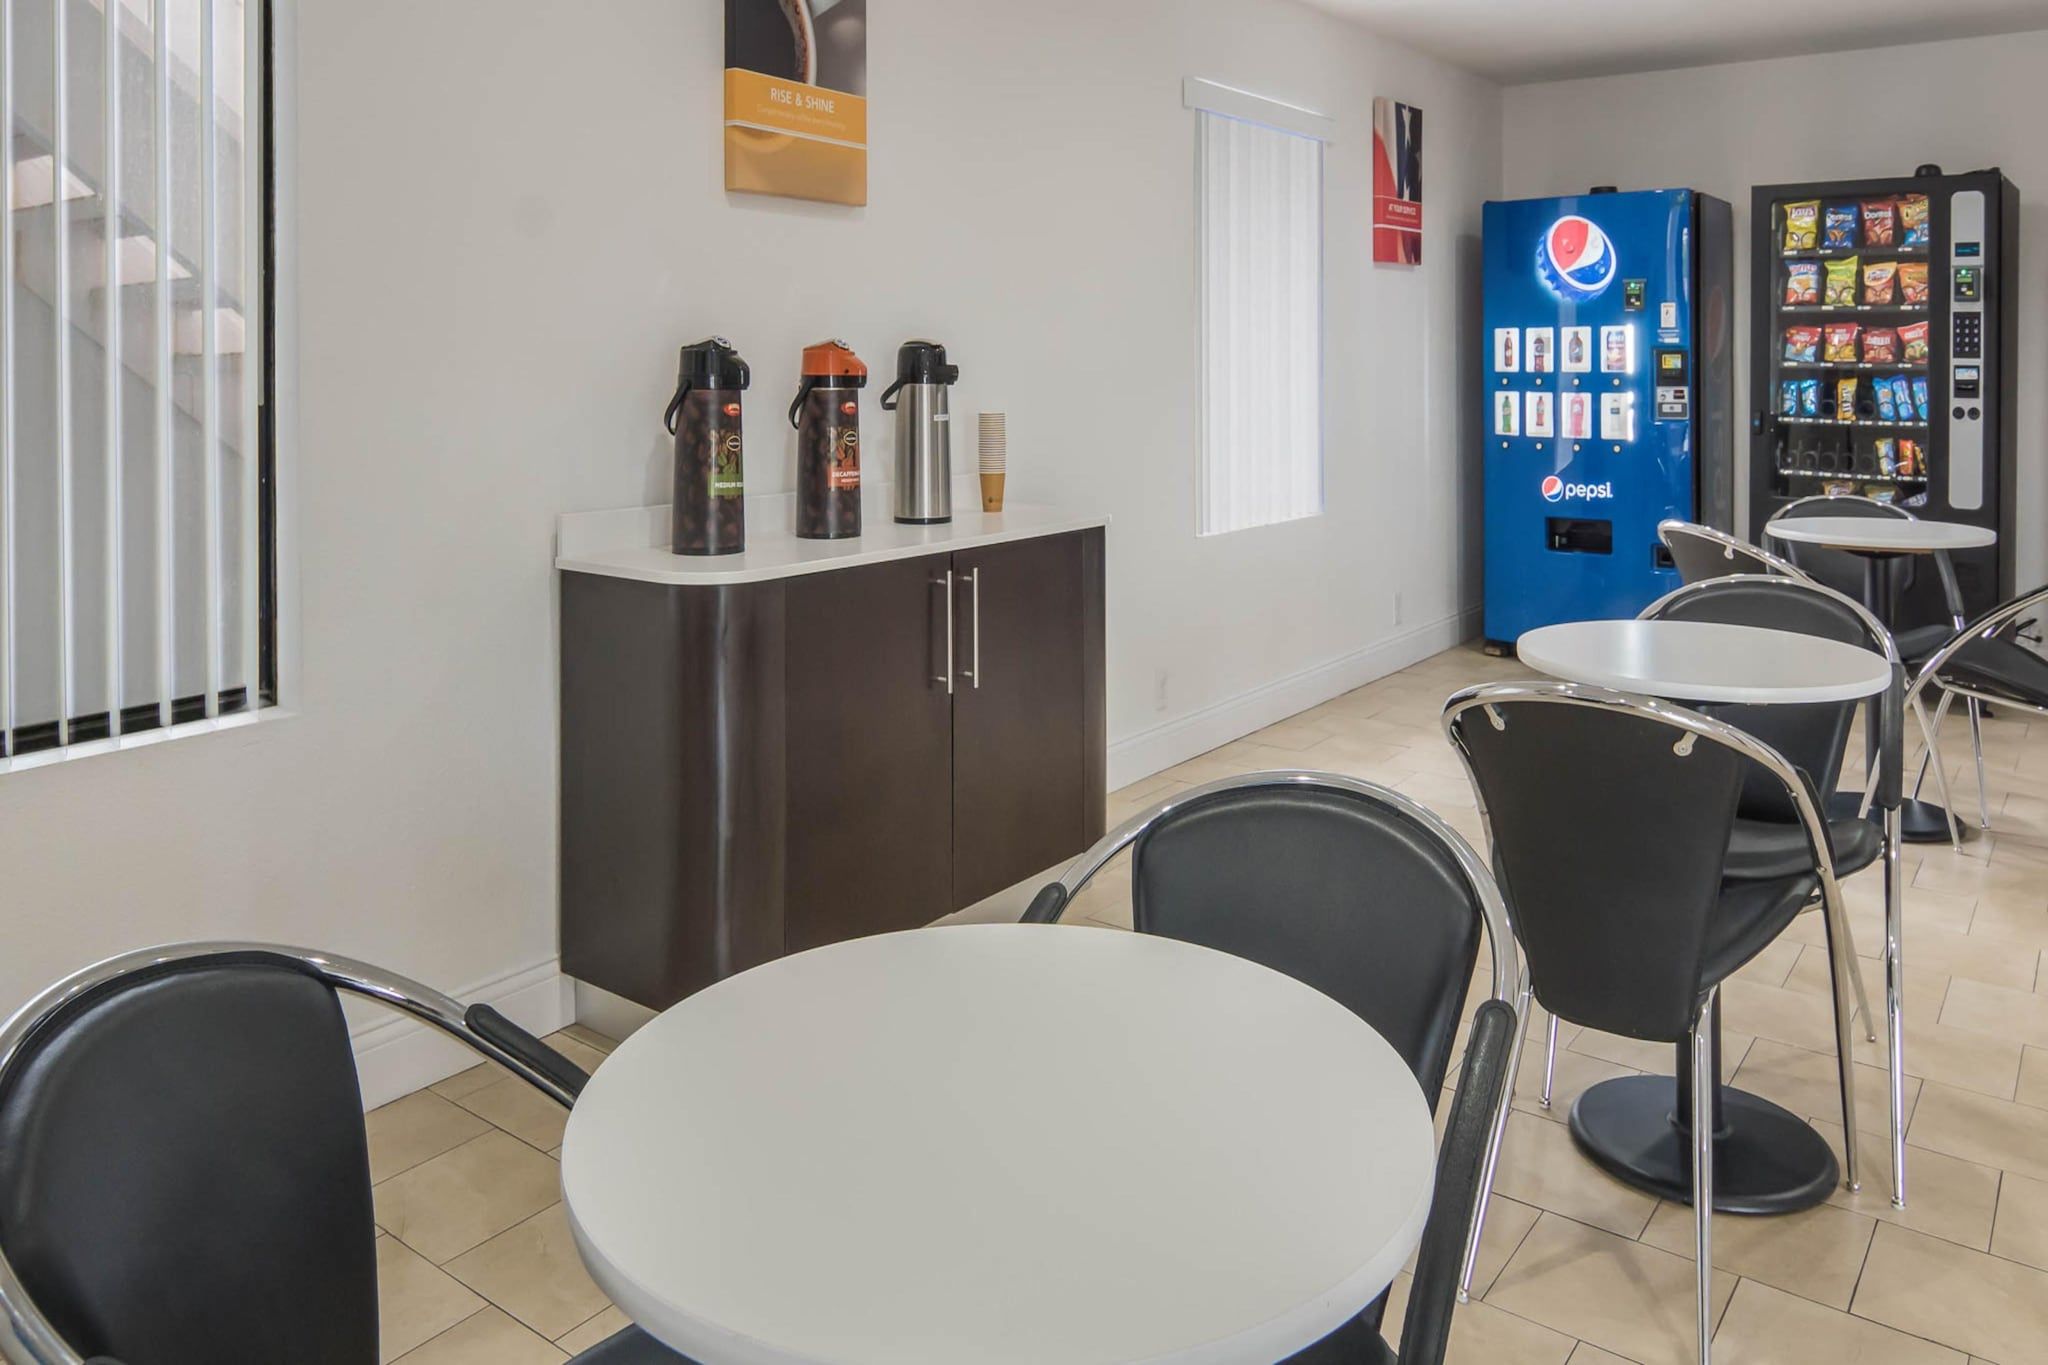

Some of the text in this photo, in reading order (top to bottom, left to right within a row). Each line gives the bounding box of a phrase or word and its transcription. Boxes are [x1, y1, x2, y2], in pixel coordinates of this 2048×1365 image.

[770, 88, 835, 114] RISE & SHINE
[1565, 481, 1612, 501] pepsi
